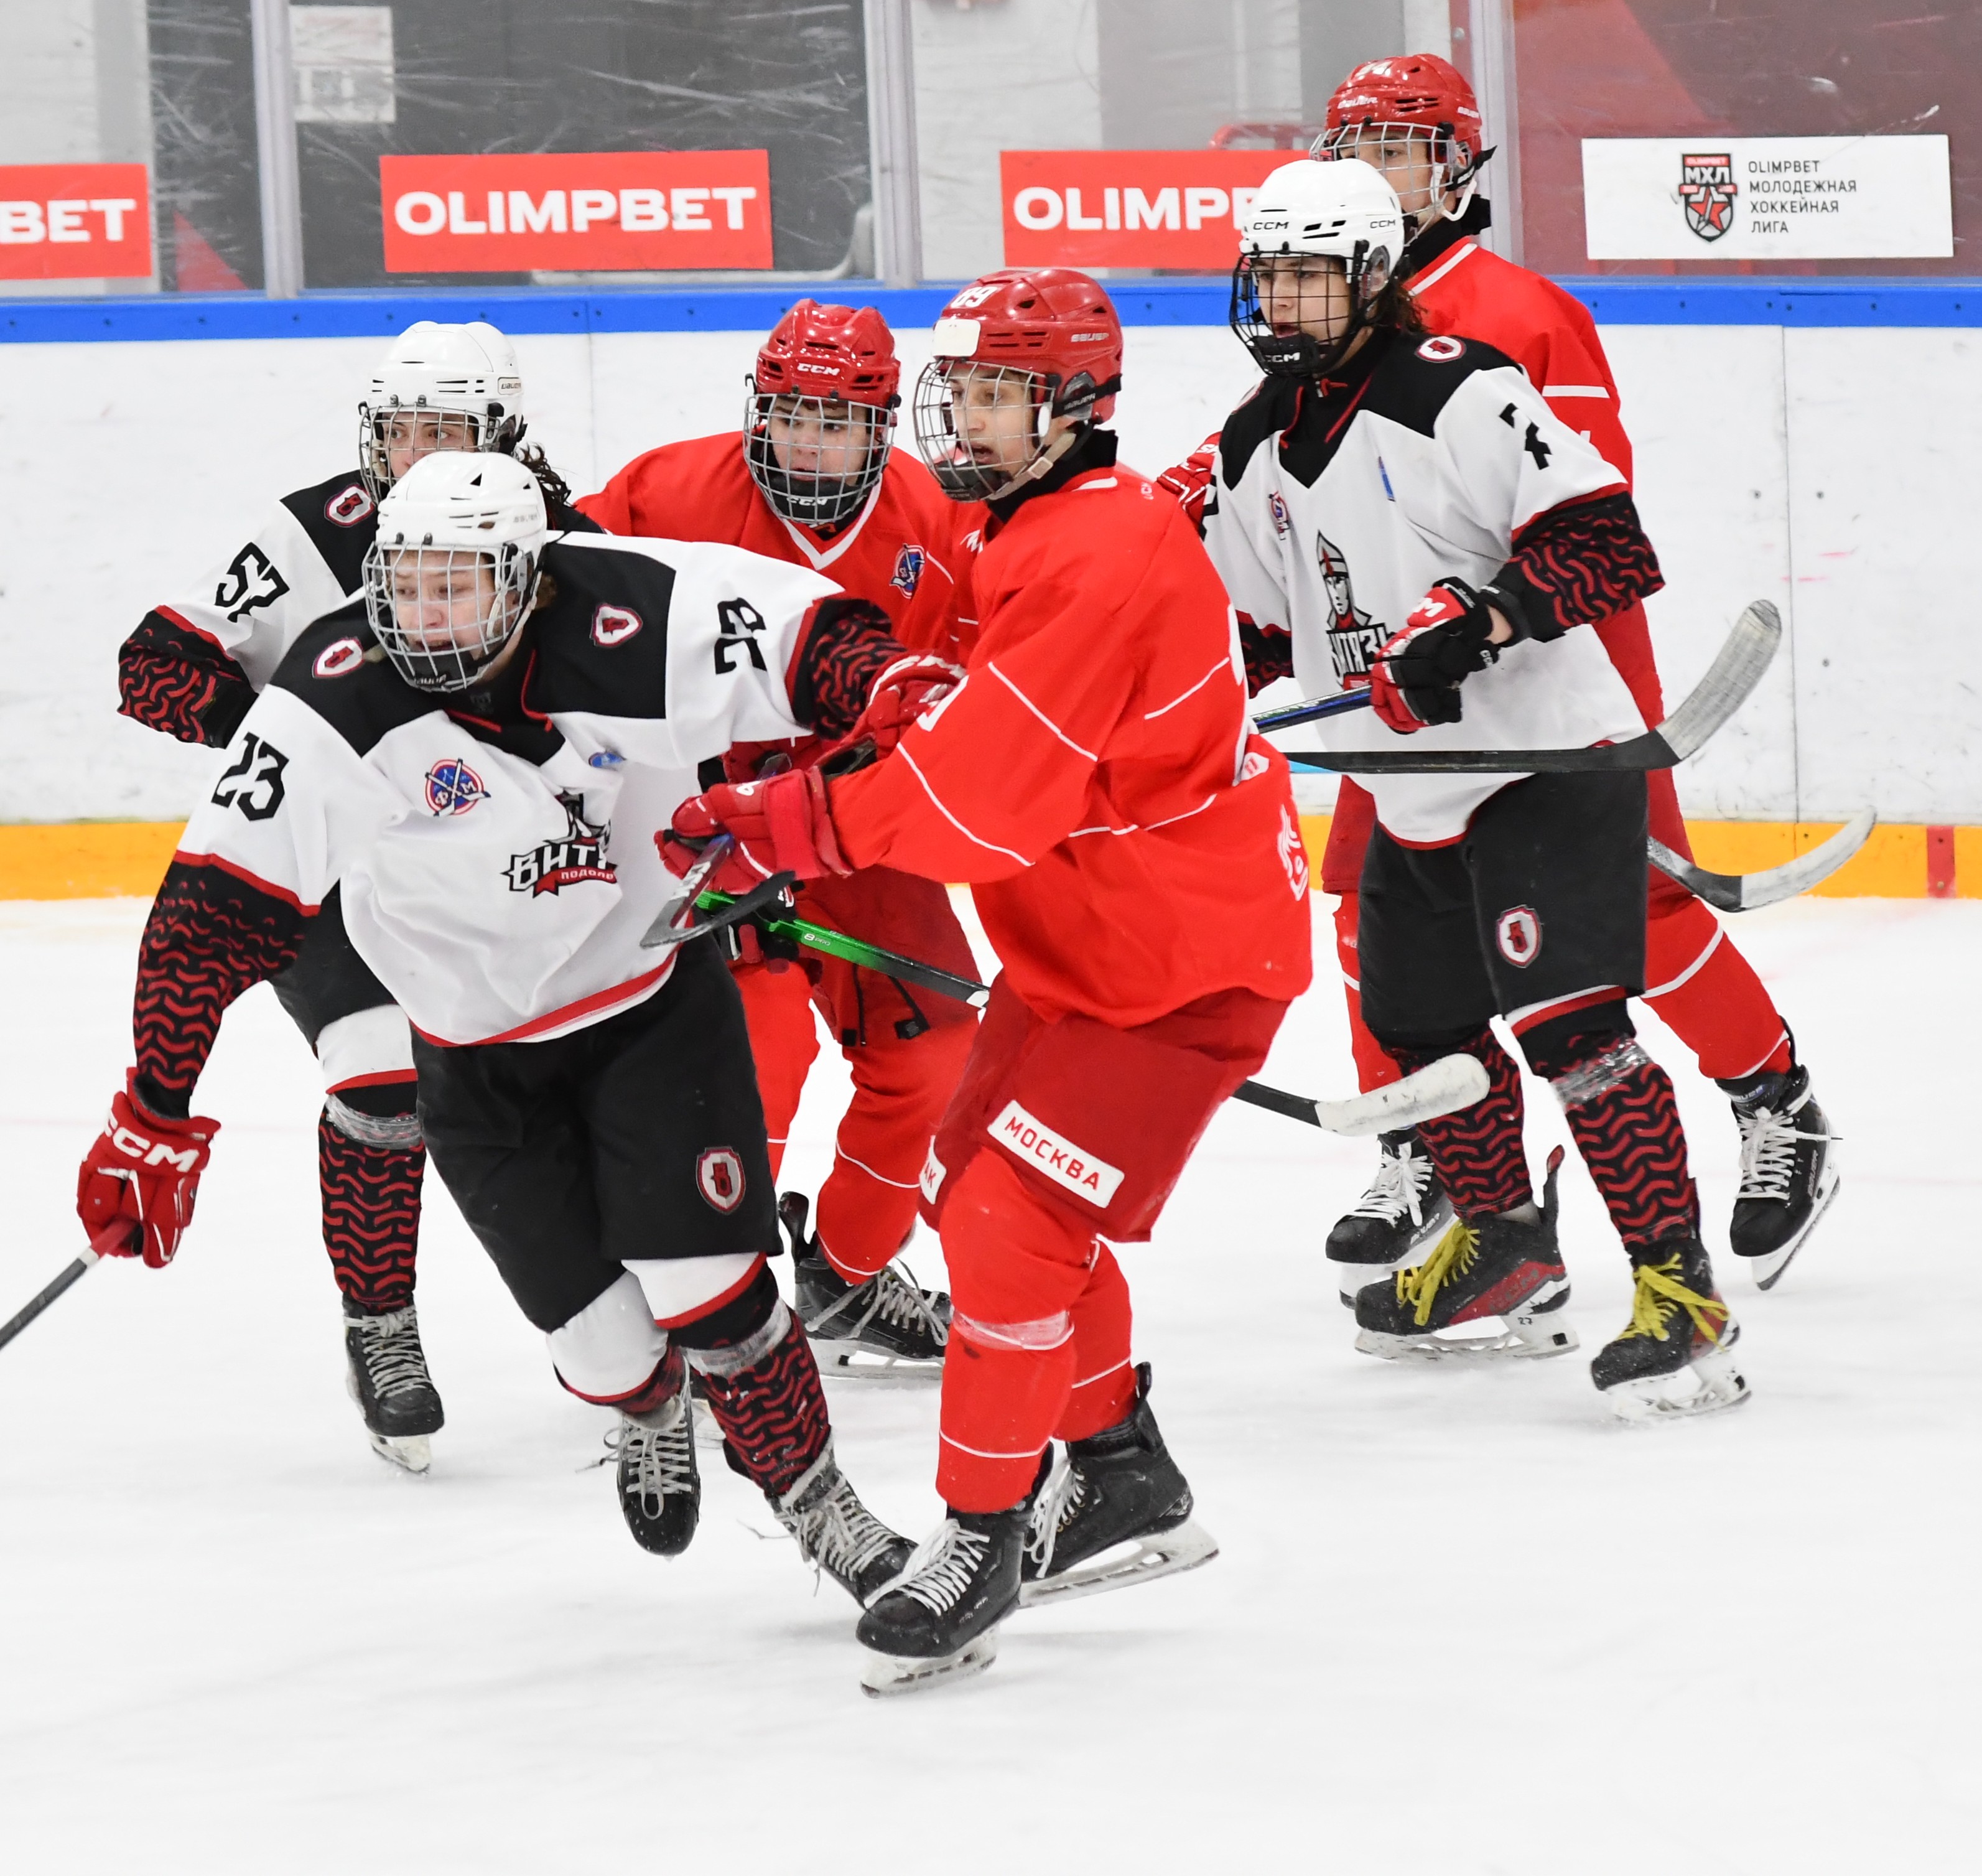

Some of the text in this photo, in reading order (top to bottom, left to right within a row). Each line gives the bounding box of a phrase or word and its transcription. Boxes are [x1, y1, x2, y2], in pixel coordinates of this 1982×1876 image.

[1685, 166, 1730, 184] МХЛ
[1748, 160, 1820, 174] OLIMPBET
[1749, 180, 1857, 195] МОЛОДЕЖНАЯ
[394, 187, 756, 236] OLIMPBET
[1750, 196, 1840, 213] ХОККЕЙНАЯ
[1253, 222, 1289, 230] CCM
[1370, 220, 1396, 229] CCM
[1751, 220, 1789, 233] ЛИГА
[950, 286, 998, 308] 89
[797, 362, 840, 376] CCM
[210, 730, 290, 822] 23
[1004, 1116, 1100, 1190] МОСКВА
